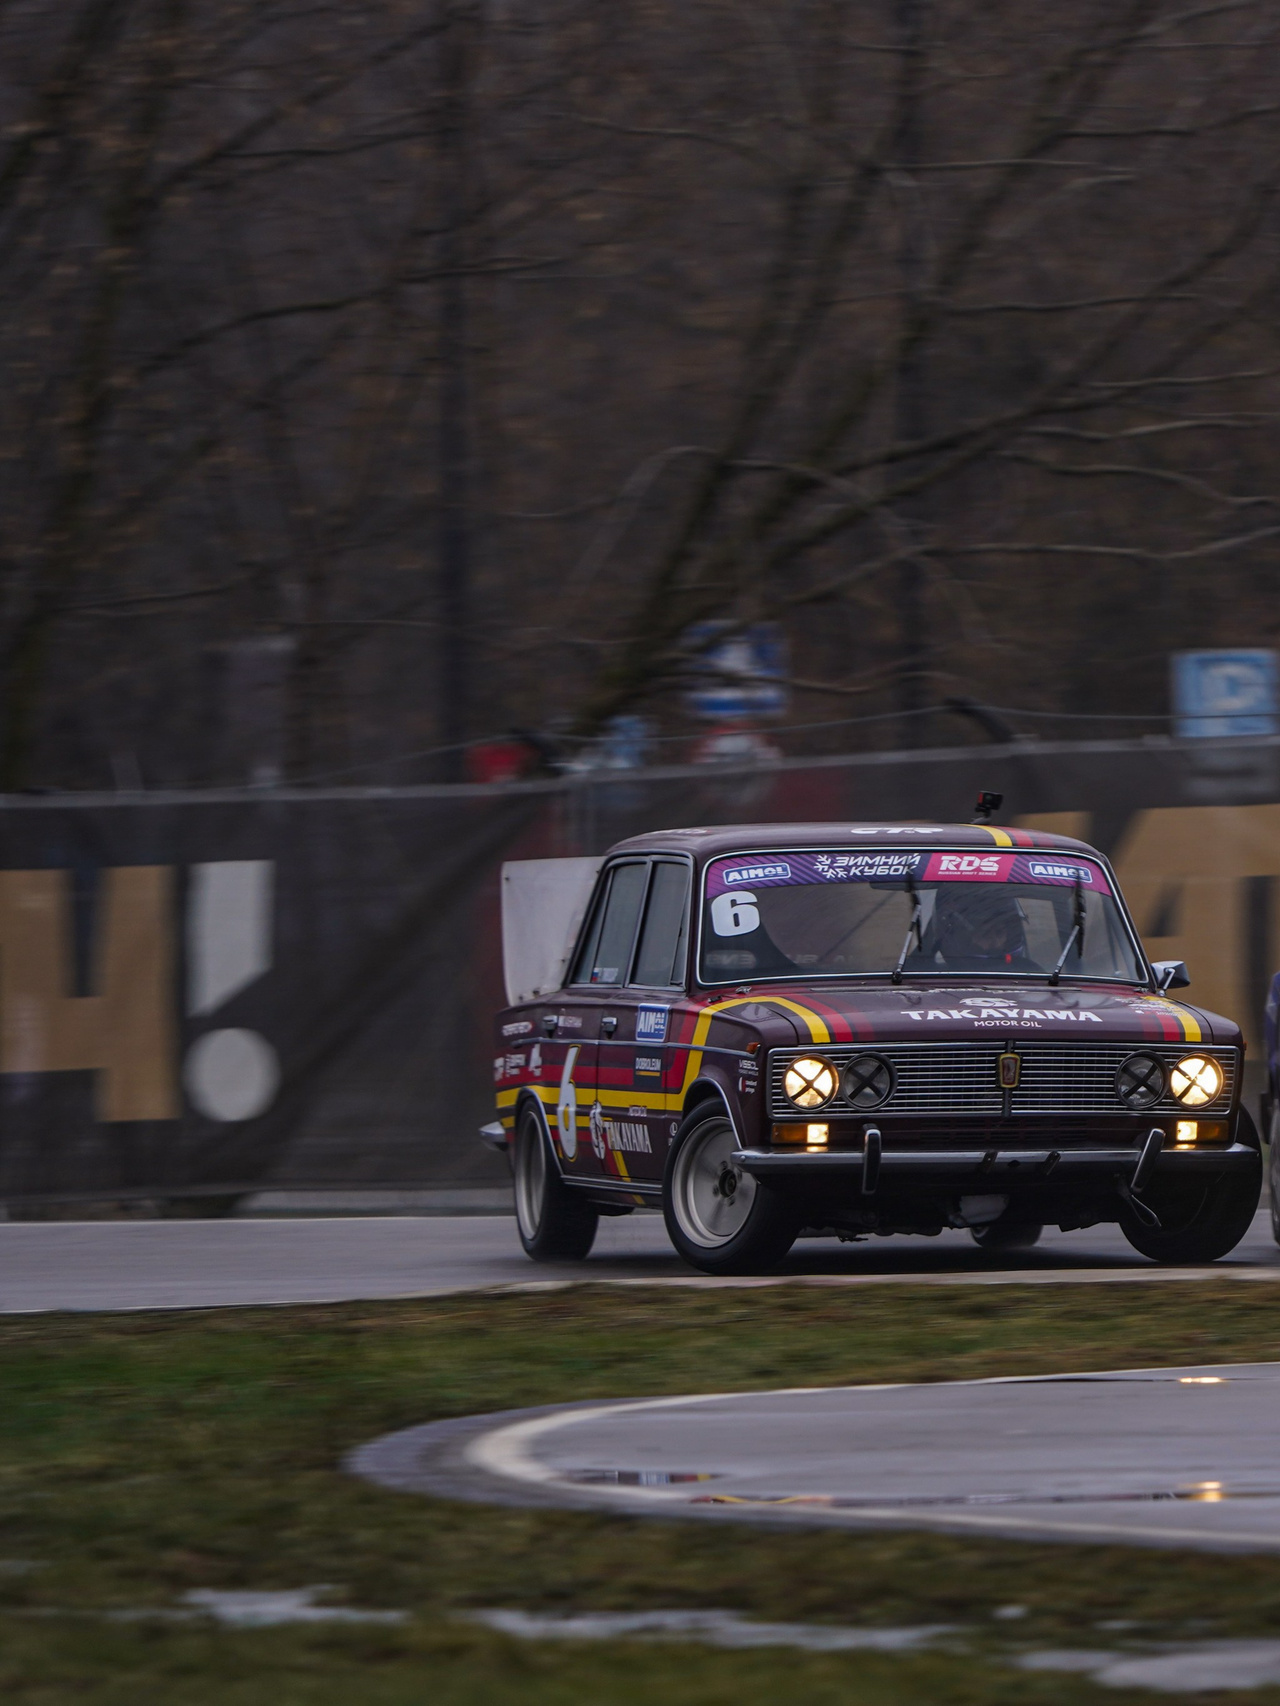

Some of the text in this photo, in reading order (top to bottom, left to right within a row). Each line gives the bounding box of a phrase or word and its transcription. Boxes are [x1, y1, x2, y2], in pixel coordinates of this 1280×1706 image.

[833, 853, 921, 866] ЗИМНИЙ
[940, 856, 1002, 871] RDS
[727, 865, 788, 882] AIMOL
[849, 865, 917, 876] КУБОК
[1033, 865, 1091, 881] AIMOL
[711, 890, 760, 937] 6
[900, 1008, 1103, 1022] TAKAYAMA
[556, 1045, 580, 1162] 6
[603, 1121, 653, 1154] TAKAYAMA
